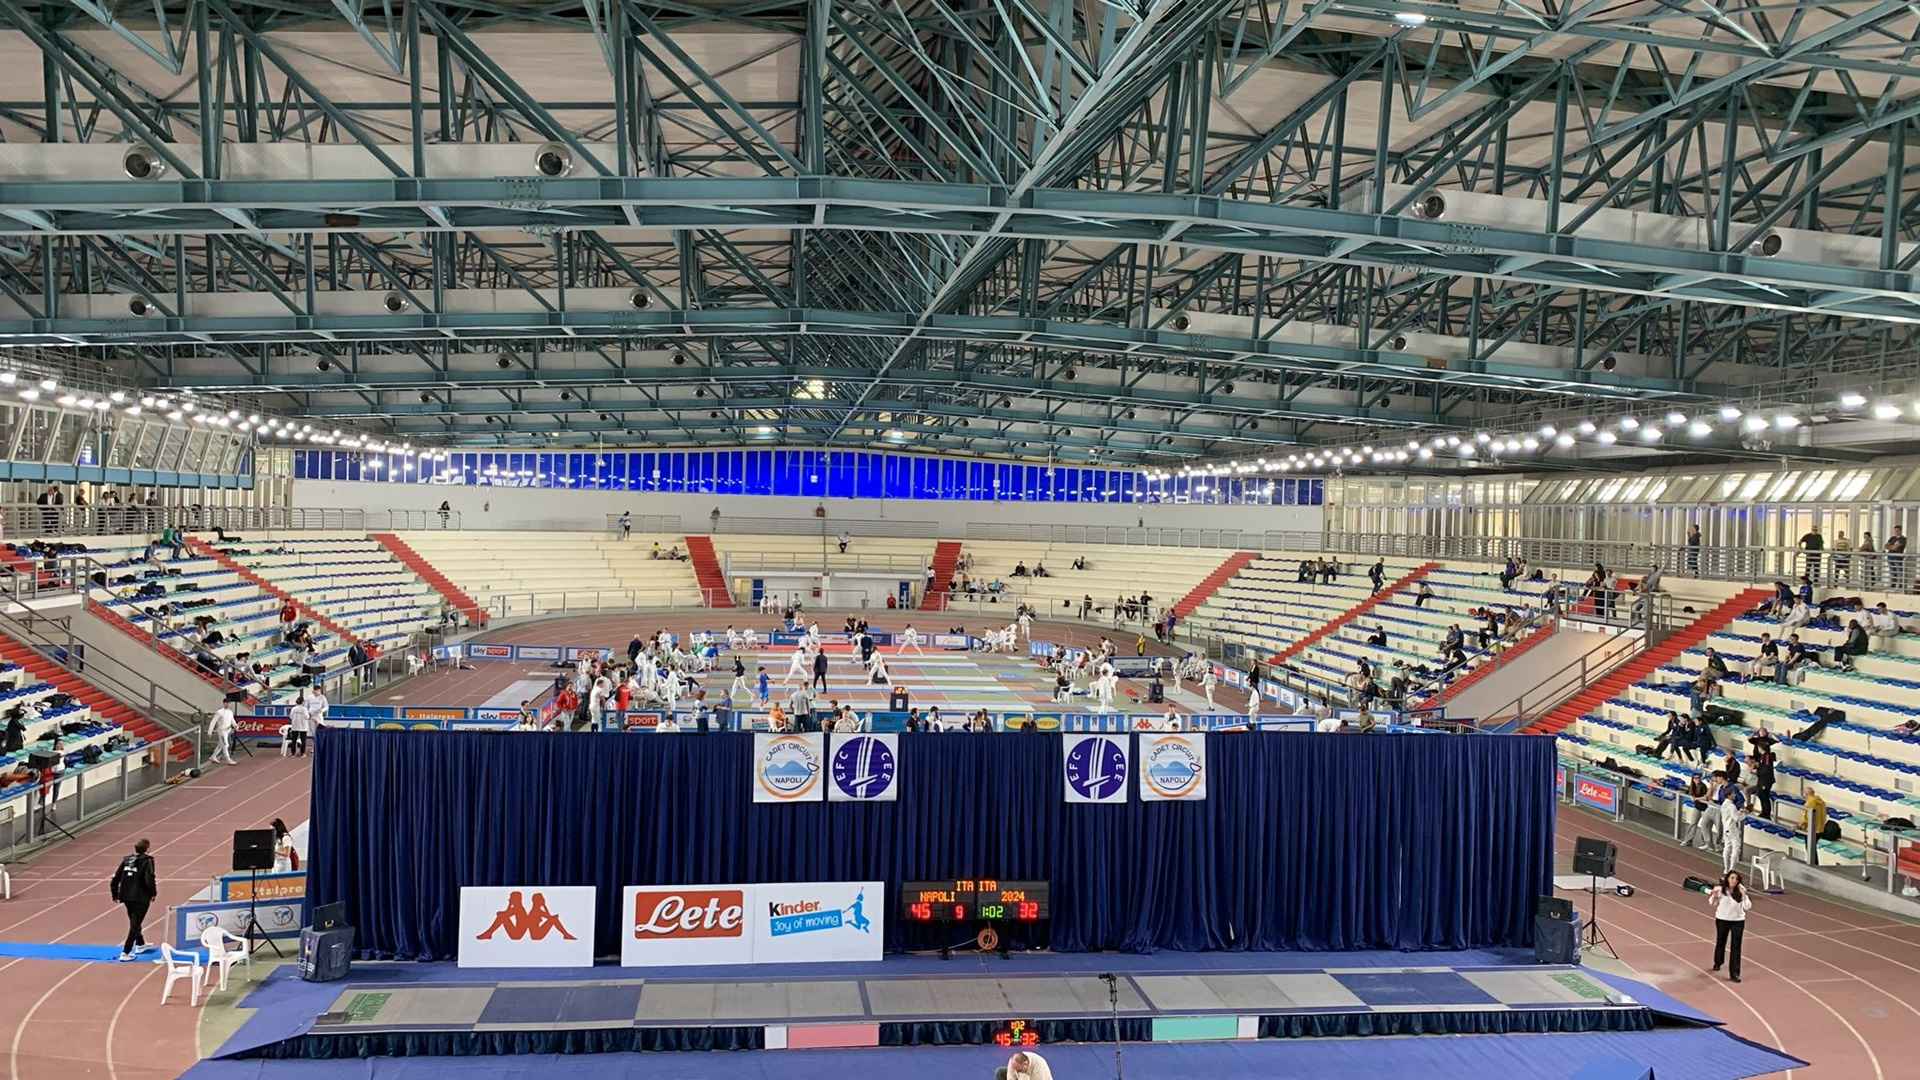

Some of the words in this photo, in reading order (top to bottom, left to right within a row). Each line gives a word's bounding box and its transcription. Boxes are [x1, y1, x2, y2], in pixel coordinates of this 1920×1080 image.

[473, 647, 485, 655] sky
[236, 720, 264, 732] Lete
[629, 717, 657, 726] sport
[765, 743, 787, 762] CADET
[788, 742, 812, 760] CIRCUIT
[1150, 743, 1169, 762] CADET
[1171, 743, 1195, 761] CIRCUIT
[837, 750, 849, 781] EFC
[881, 752, 892, 781] CEE
[1069, 751, 1081, 782] EFC
[1113, 753, 1124, 782] CEE
[775, 776, 802, 784] NAPOLI
[1160, 776, 1186, 784] NAPOLI
[956, 881, 974, 892] ITA
[979, 881, 997, 892] ITA
[920, 892, 955, 902] NAPOLI
[1001, 891, 1025, 902] 2024
[636, 896, 743, 935] Lete
[911, 904, 931, 919] 45
[955, 905, 963, 918] 9
[982, 906, 1004, 918] 1:02
[1020, 903, 1038, 918] 32
[774, 921, 791, 933] Joy
[793, 917, 803, 929] of
[805, 915, 839, 927] moving
[1010, 1020, 1026, 1030] 1:02
[996, 1033, 1011, 1046] 45
[1022, 1032, 1036, 1046] 32
